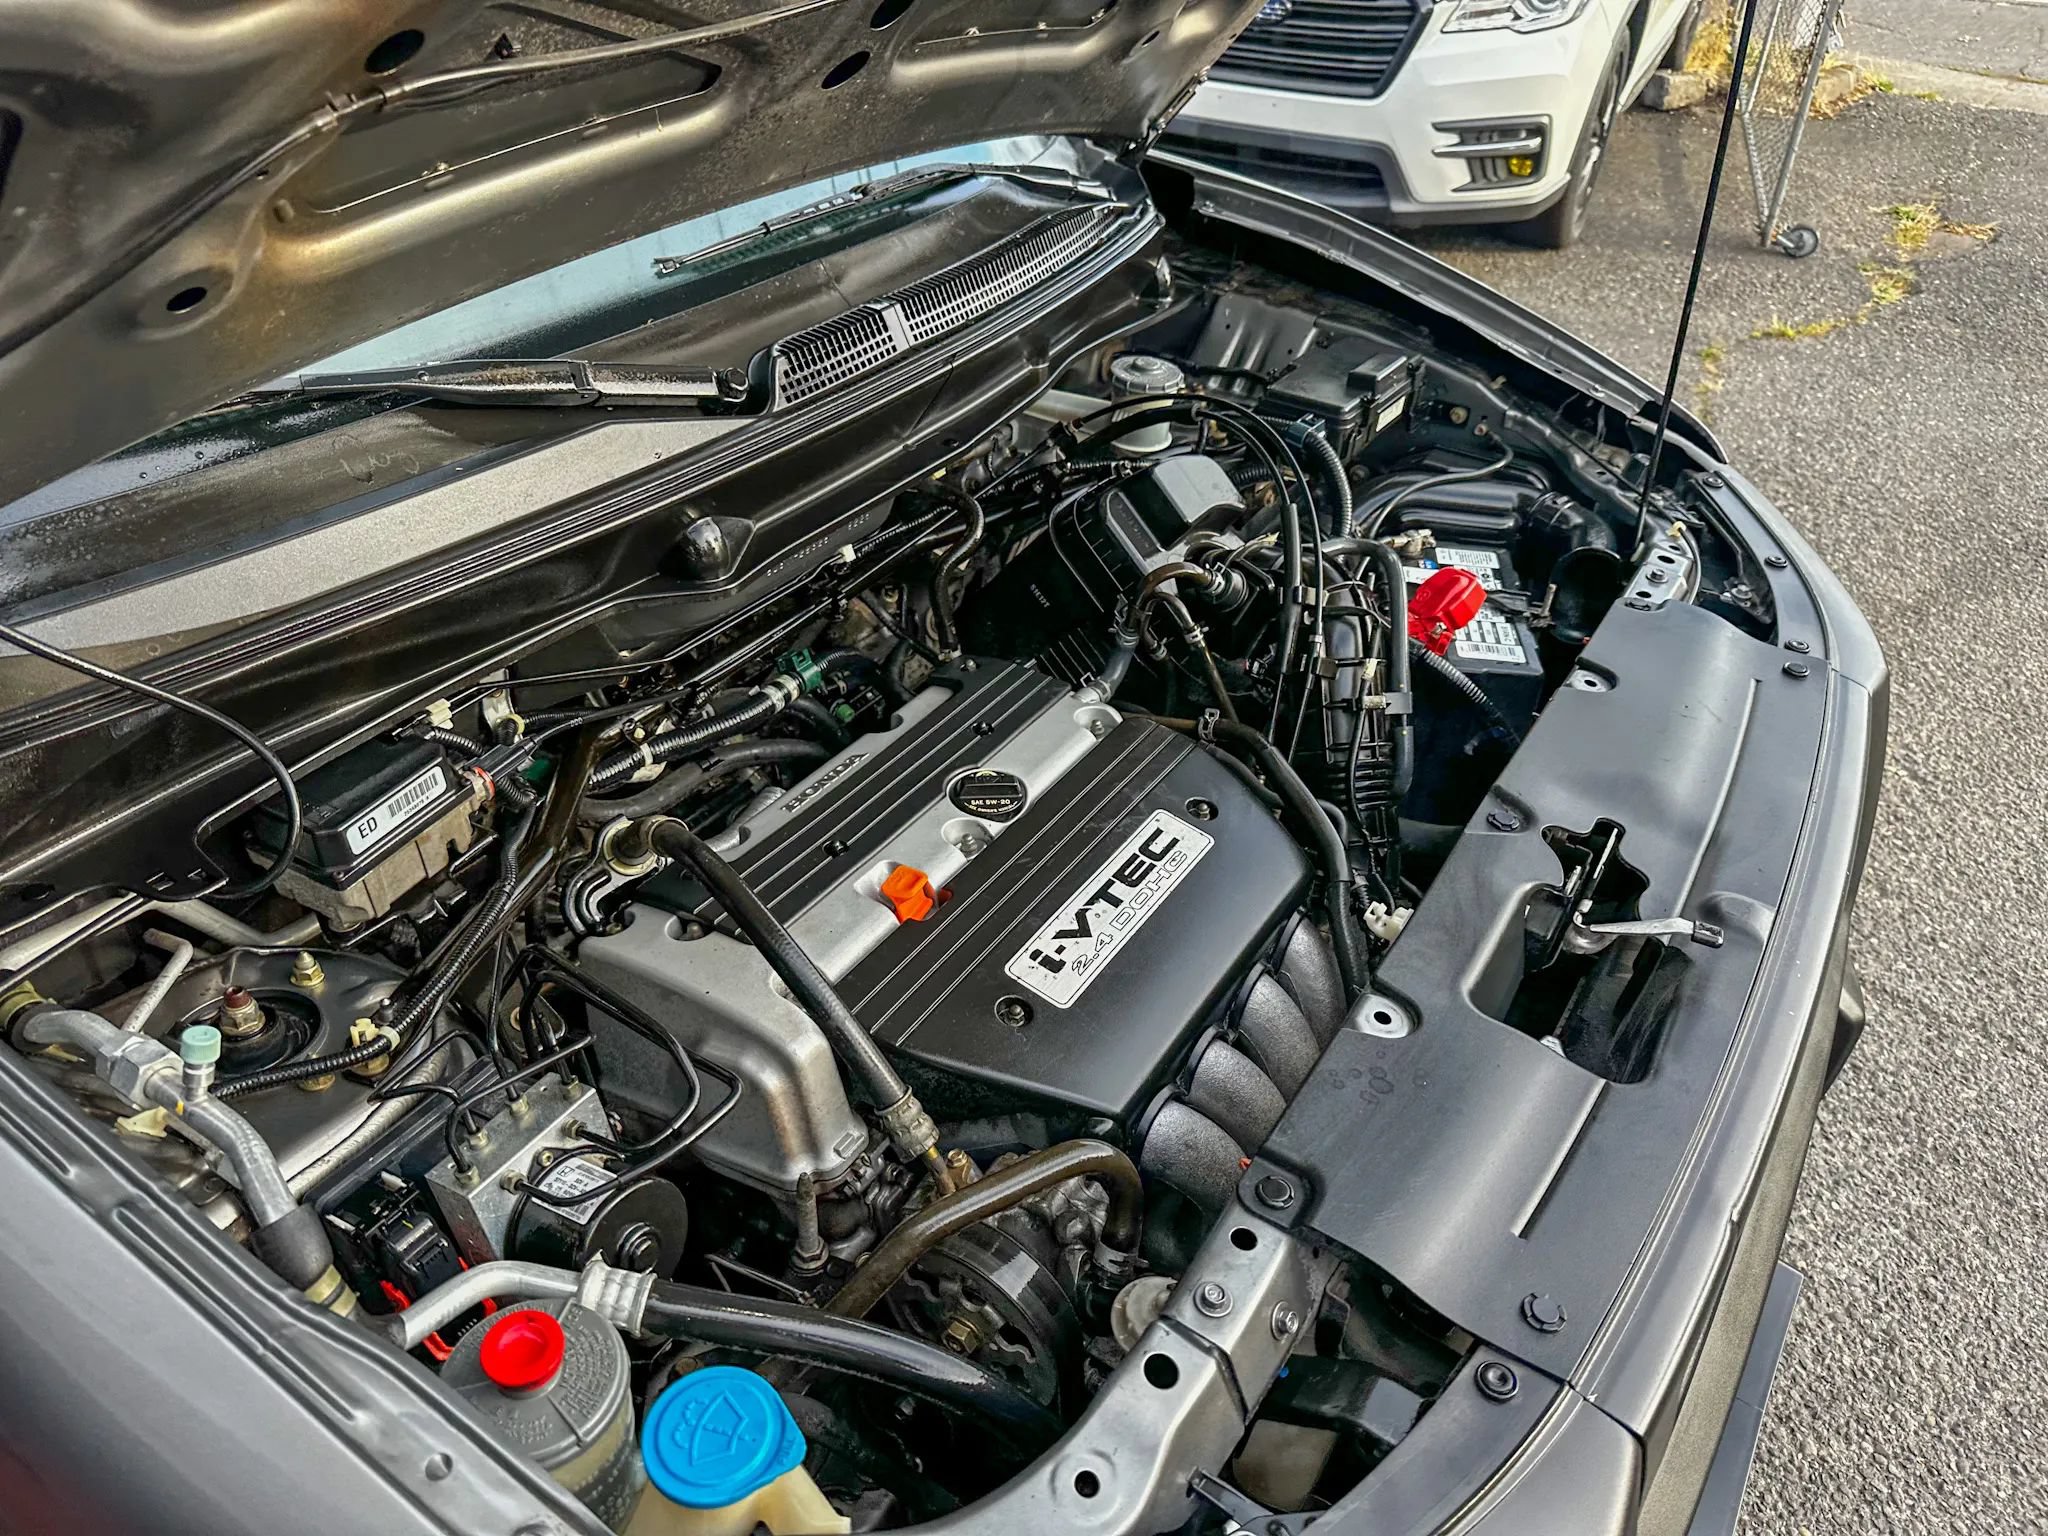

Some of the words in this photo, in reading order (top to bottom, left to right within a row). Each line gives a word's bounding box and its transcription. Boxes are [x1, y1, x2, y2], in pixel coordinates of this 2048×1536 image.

[357, 816, 378, 840] ED
[780, 753, 869, 813] HONDA
[1028, 826, 1181, 975] i-VTEC
[1071, 931, 1115, 977] 2.4
[1108, 849, 1188, 932] DOHC
